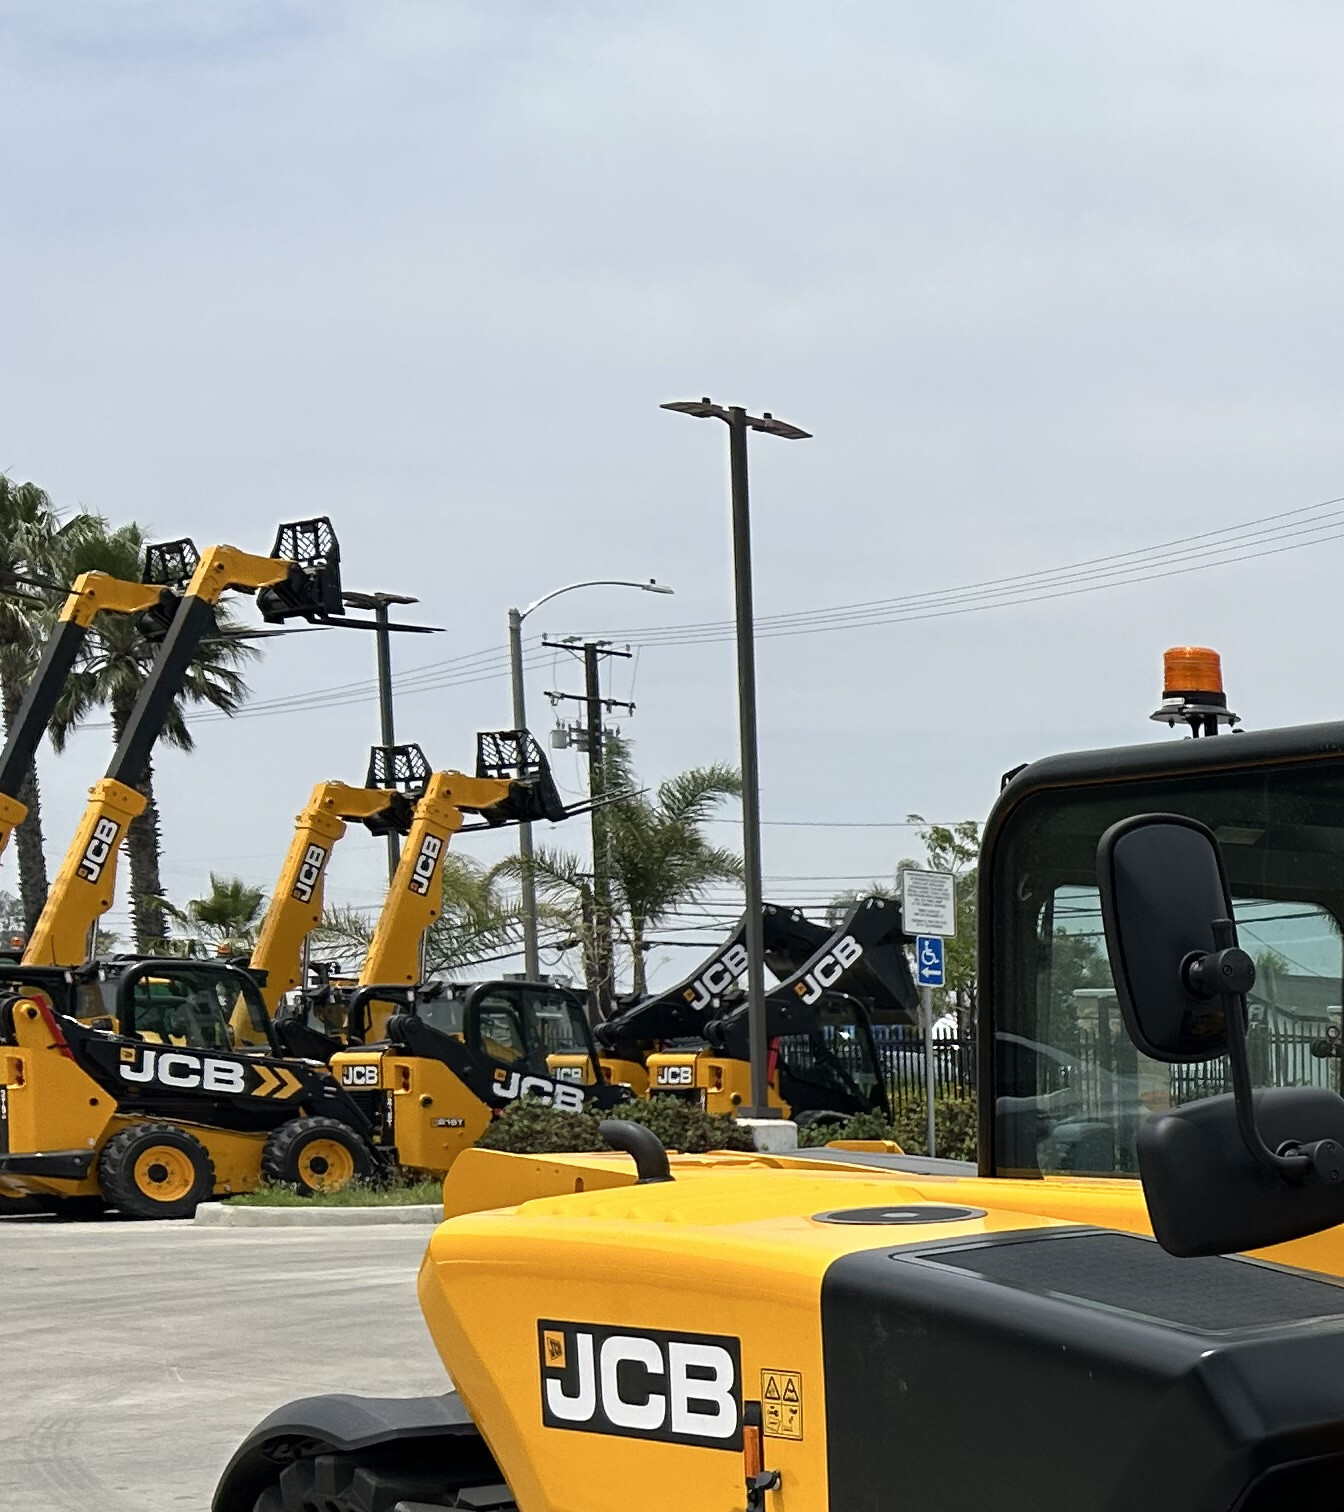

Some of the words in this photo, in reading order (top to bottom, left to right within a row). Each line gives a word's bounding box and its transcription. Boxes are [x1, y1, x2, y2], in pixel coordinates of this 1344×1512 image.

[86, 818, 118, 882] JCB
[296, 845, 326, 902] JCB
[413, 836, 442, 895] JCB
[691, 944, 749, 1010] JCB
[802, 935, 864, 1005] JCB
[120, 1050, 245, 1093] JCB
[343, 1066, 378, 1085] JCB
[493, 1073, 585, 1114] JCB
[658, 1067, 692, 1084] JCB
[546, 1332, 738, 1439] JCB
